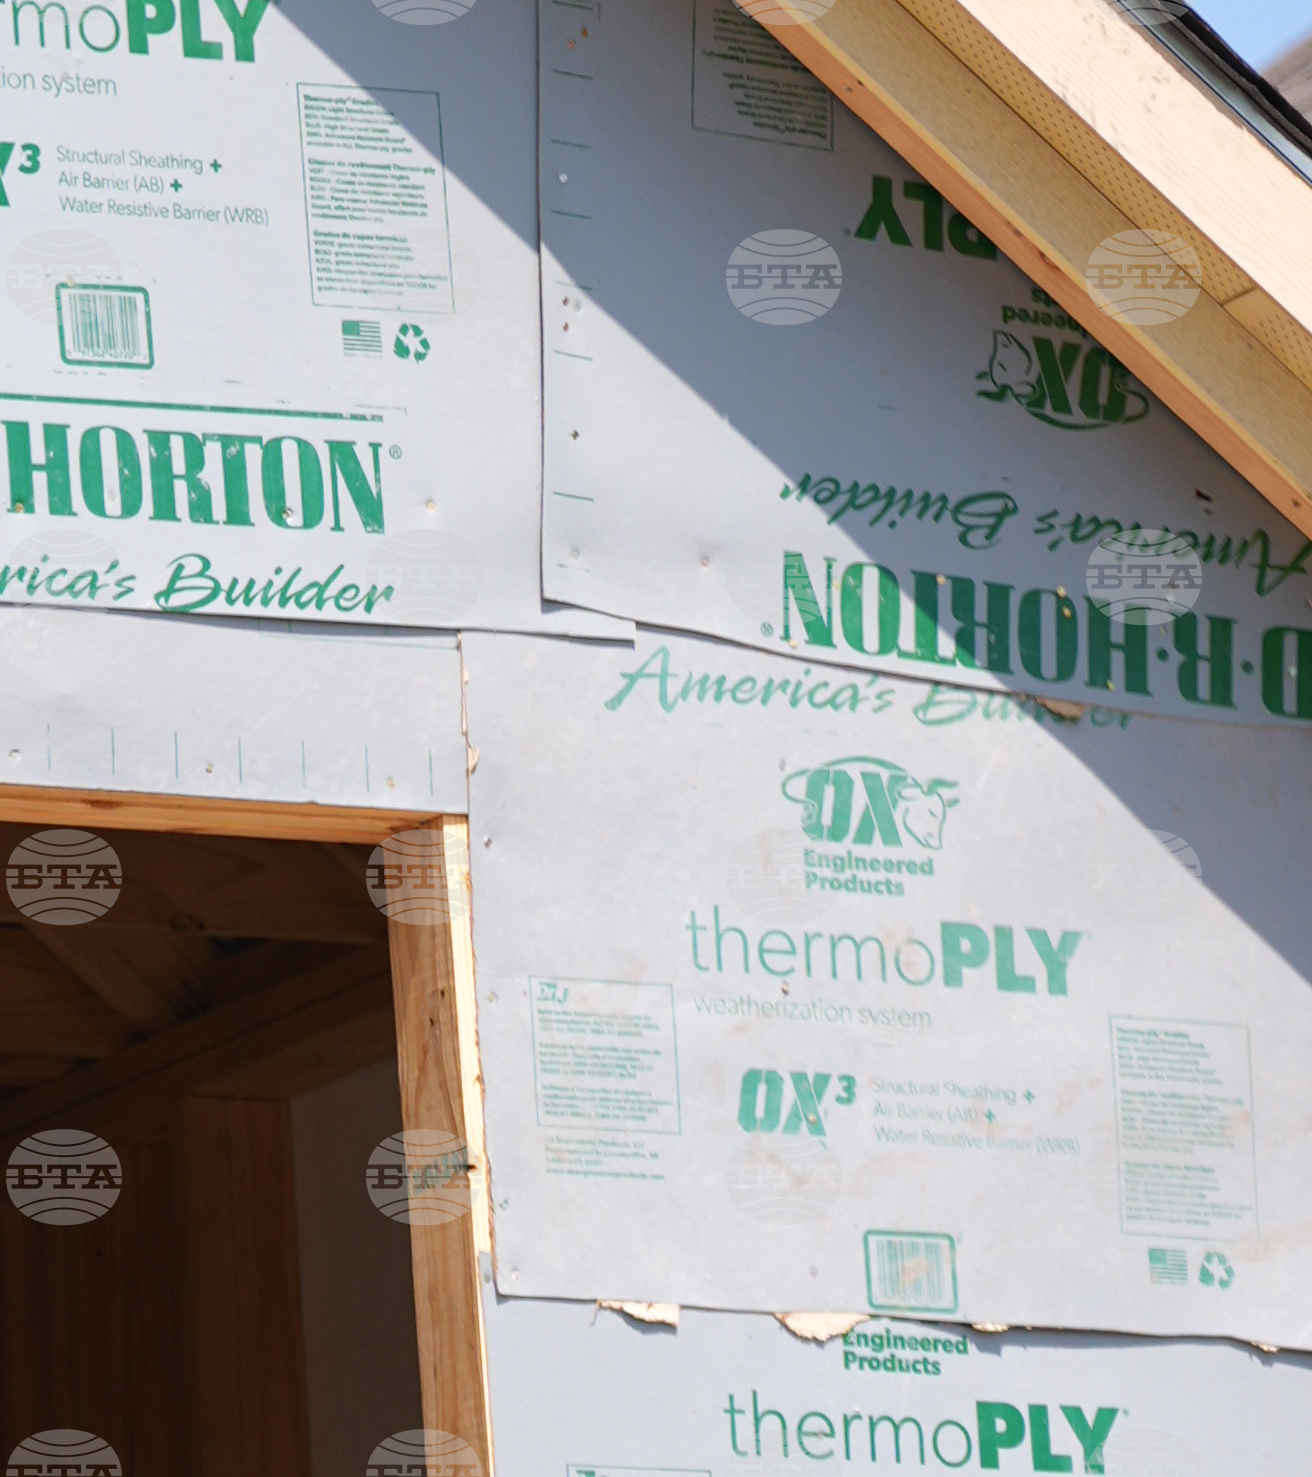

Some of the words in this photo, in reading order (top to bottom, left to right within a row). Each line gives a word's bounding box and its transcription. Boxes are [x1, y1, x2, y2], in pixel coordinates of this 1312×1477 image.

[155, 556, 393, 614] Builder
[606, 647, 893, 714] America's
[689, 905, 1082, 997] thermoPLY
[843, 1342, 940, 1376] Products
[726, 1393, 1118, 1475] thermoPLY
